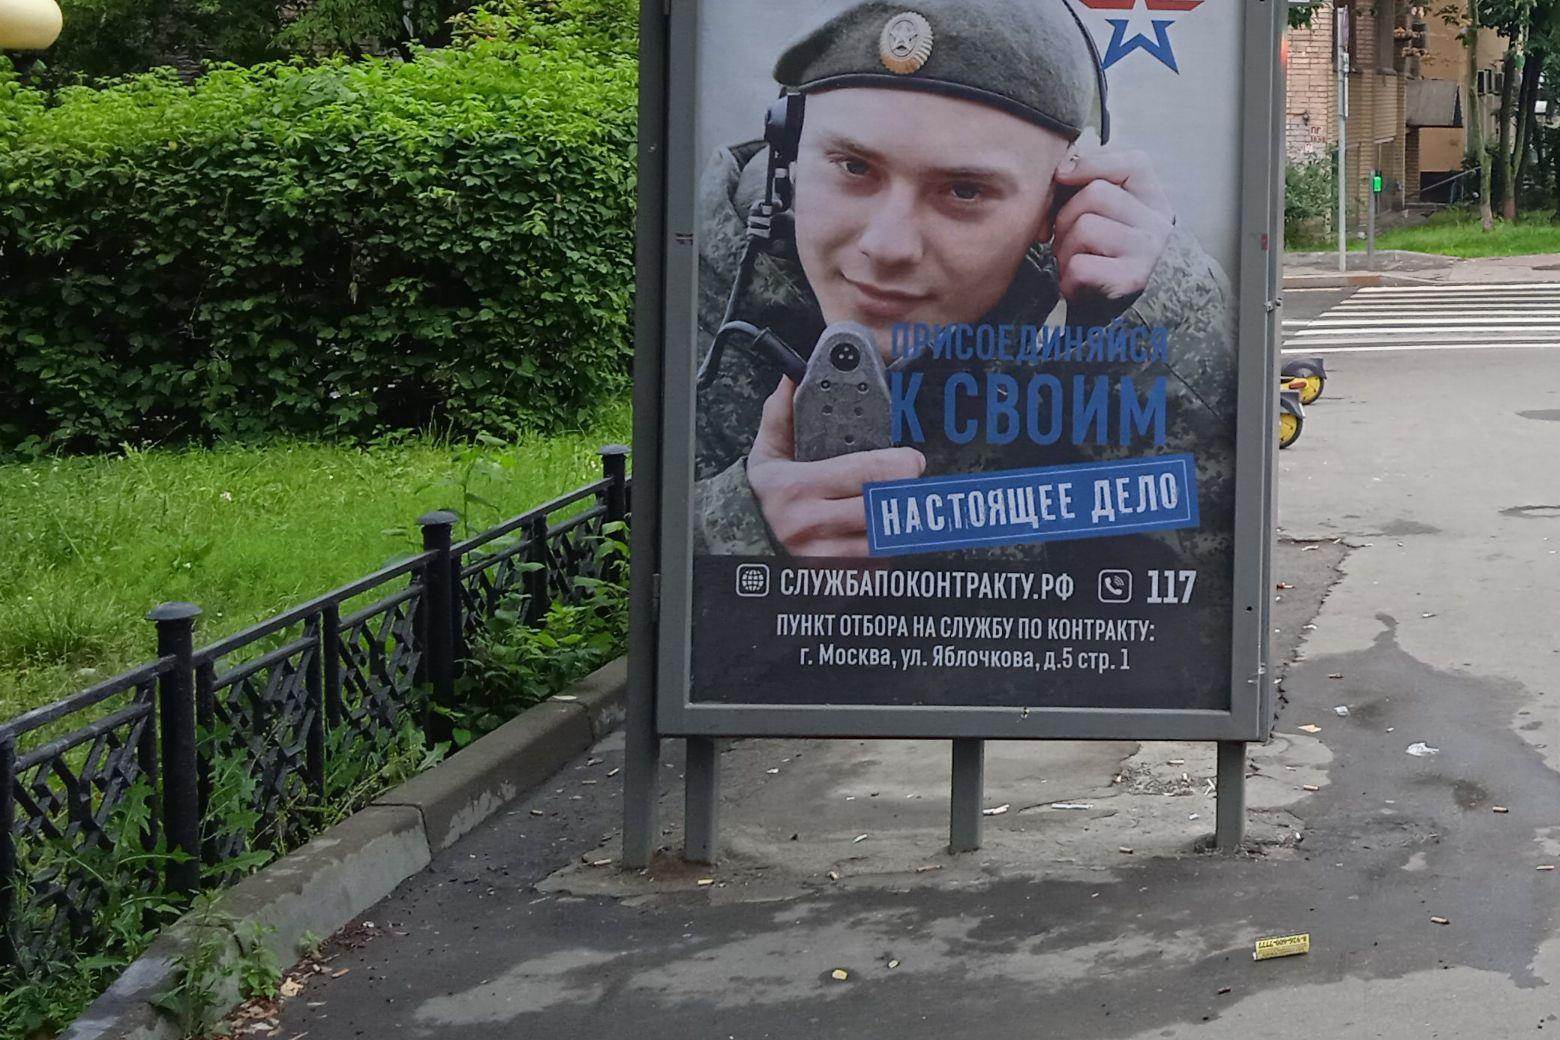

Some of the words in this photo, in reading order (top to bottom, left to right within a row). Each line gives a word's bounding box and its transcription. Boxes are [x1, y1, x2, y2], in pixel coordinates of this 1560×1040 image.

[891, 317, 1169, 364] ПРИСОЕДИНЯЙСЯ
[889, 371, 925, 444] К
[943, 371, 1168, 447] СВОИМ
[881, 482, 1076, 536] НАСТОЯЩЕЕ
[1092, 472, 1178, 523] ДЕЛО
[780, 568, 1074, 601] СЛУЖБАПОКОНТРАКТУ.РФ
[1147, 570, 1197, 604] 117
[777, 614, 836, 636] ПУНКТ
[840, 615, 908, 637] ОТБОРА
[913, 616, 936, 638] НА
[941, 616, 1014, 640] СЛУЖБУ
[1018, 618, 1042, 640] ПО
[1048, 618, 1155, 641] КОНТРАКТУ:
[800, 648, 813, 665] г.
[819, 644, 897, 669] Москва,
[901, 650, 927, 671] ул.
[932, 645, 1040, 671] Яблочкова,
[1044, 647, 1073, 671] д.5
[1078, 650, 1115, 674] стр.
[1120, 648, 1130, 669] 1
